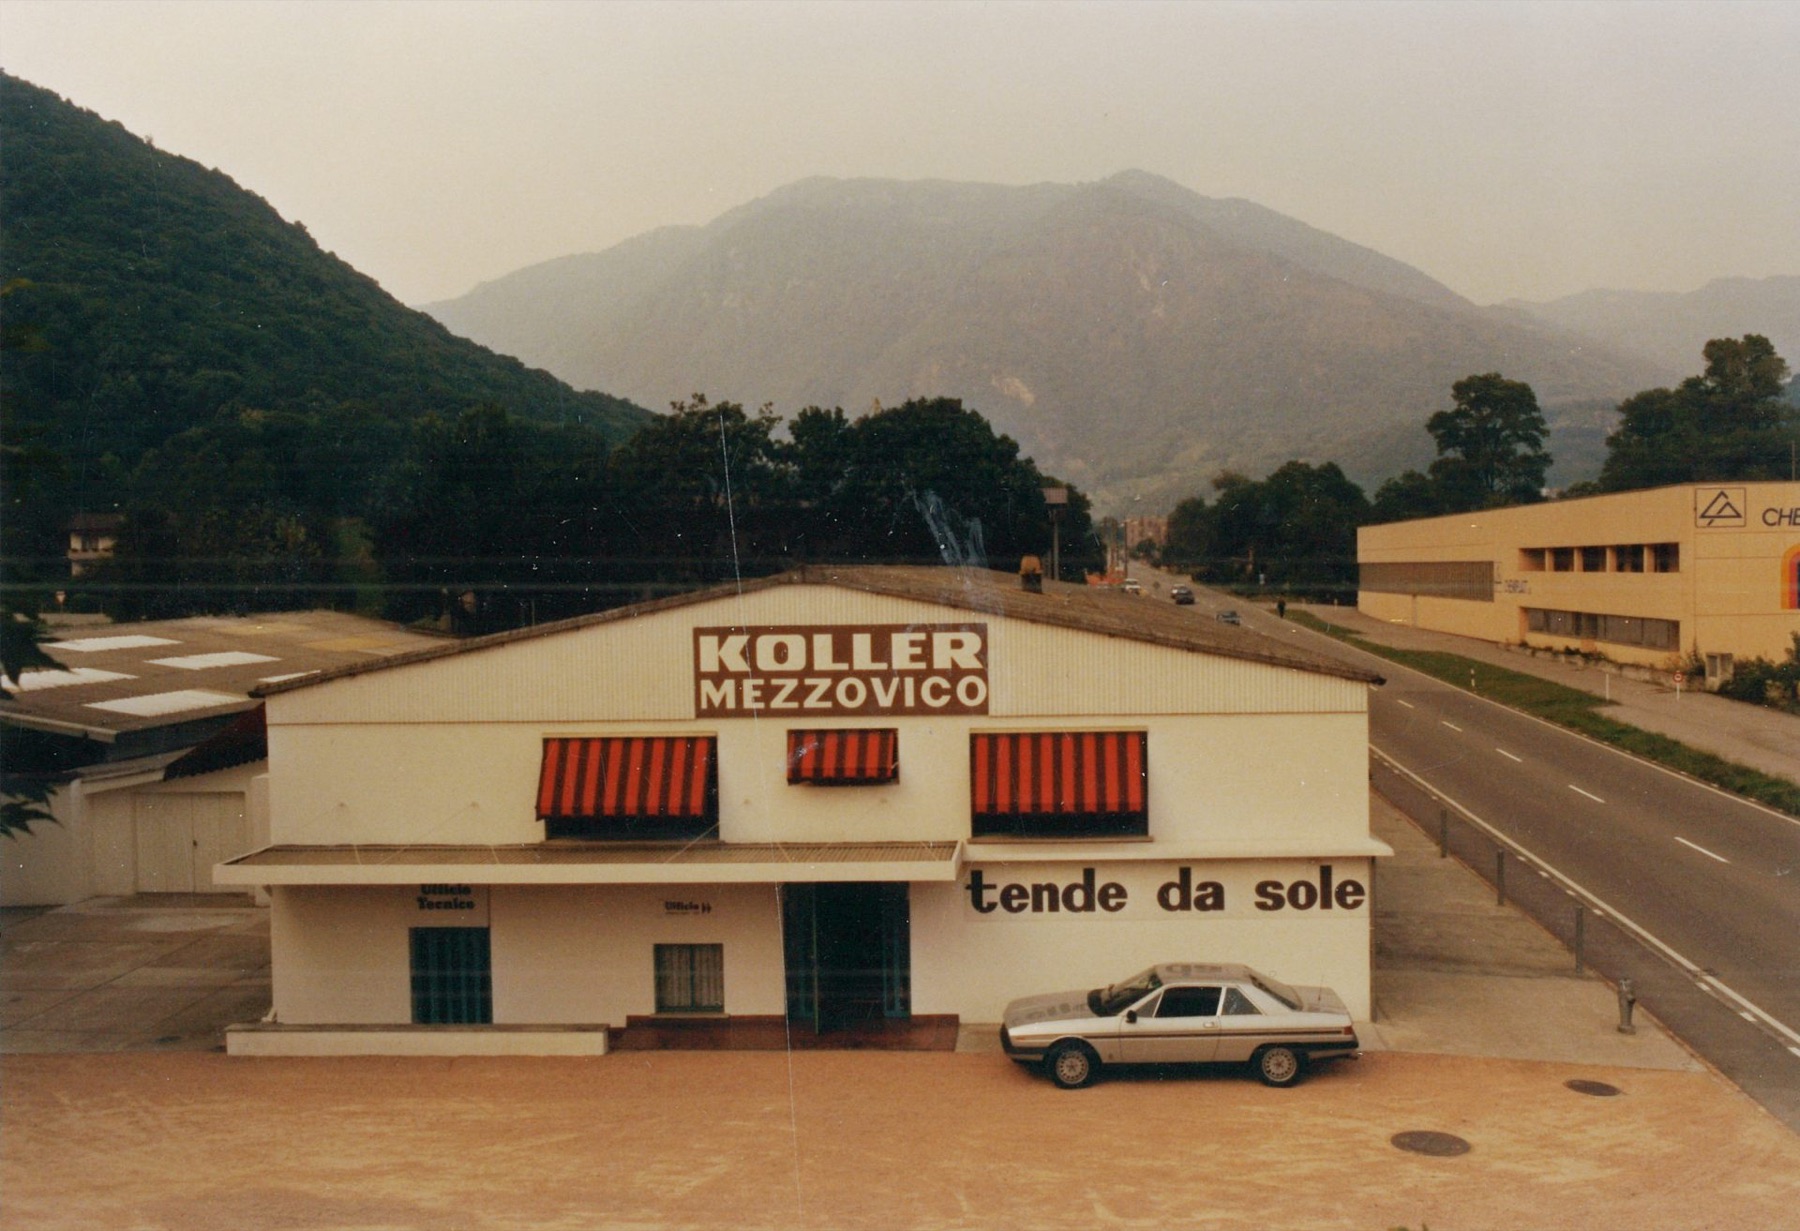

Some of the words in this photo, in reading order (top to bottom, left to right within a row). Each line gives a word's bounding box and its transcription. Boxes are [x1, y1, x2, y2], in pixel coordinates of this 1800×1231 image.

[700, 632, 983, 671] KOLLER
[701, 676, 987, 709] MEZZOVICO
[965, 869, 1128, 913] tende
[1157, 867, 1225, 911] da
[1254, 865, 1365, 910] sole
